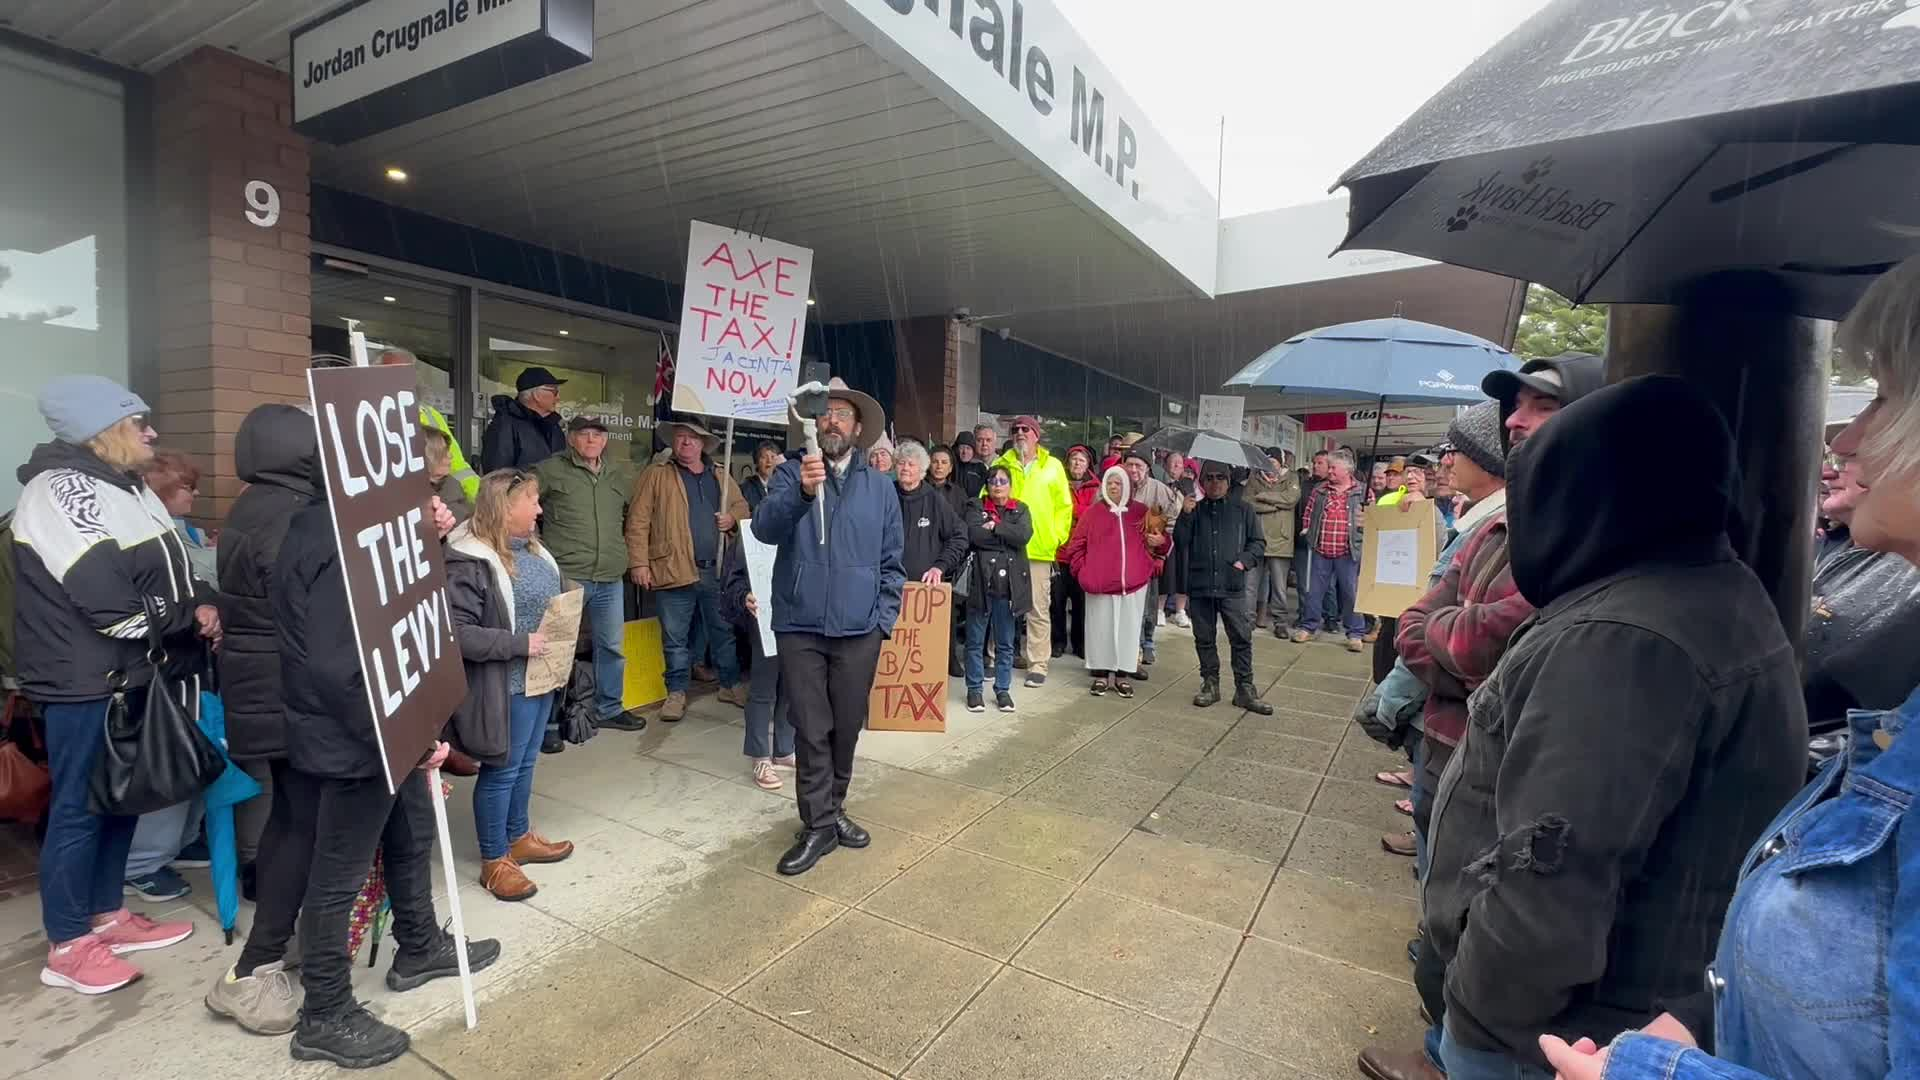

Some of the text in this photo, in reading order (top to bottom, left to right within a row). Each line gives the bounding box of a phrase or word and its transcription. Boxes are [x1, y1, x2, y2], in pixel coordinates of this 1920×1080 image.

[303, 0, 468, 88] Jordan Crugnale
[1538, 46, 1686, 89] INGREDIENTS
[1070, 64, 1139, 200] M.P.
[245, 180, 280, 227] 9
[702, 242, 799, 297] AXE
[706, 283, 769, 321] THE
[689, 306, 797, 360] TAX!
[701, 346, 793, 377] JACINTA
[706, 367, 777, 399] NOW
[325, 390, 425, 497] LOSE
[357, 507, 431, 606] THE
[372, 586, 454, 718] LEVY!
[892, 628, 921, 647] THE
[878, 648, 924, 682] B/S
[875, 681, 945, 722] TAX
